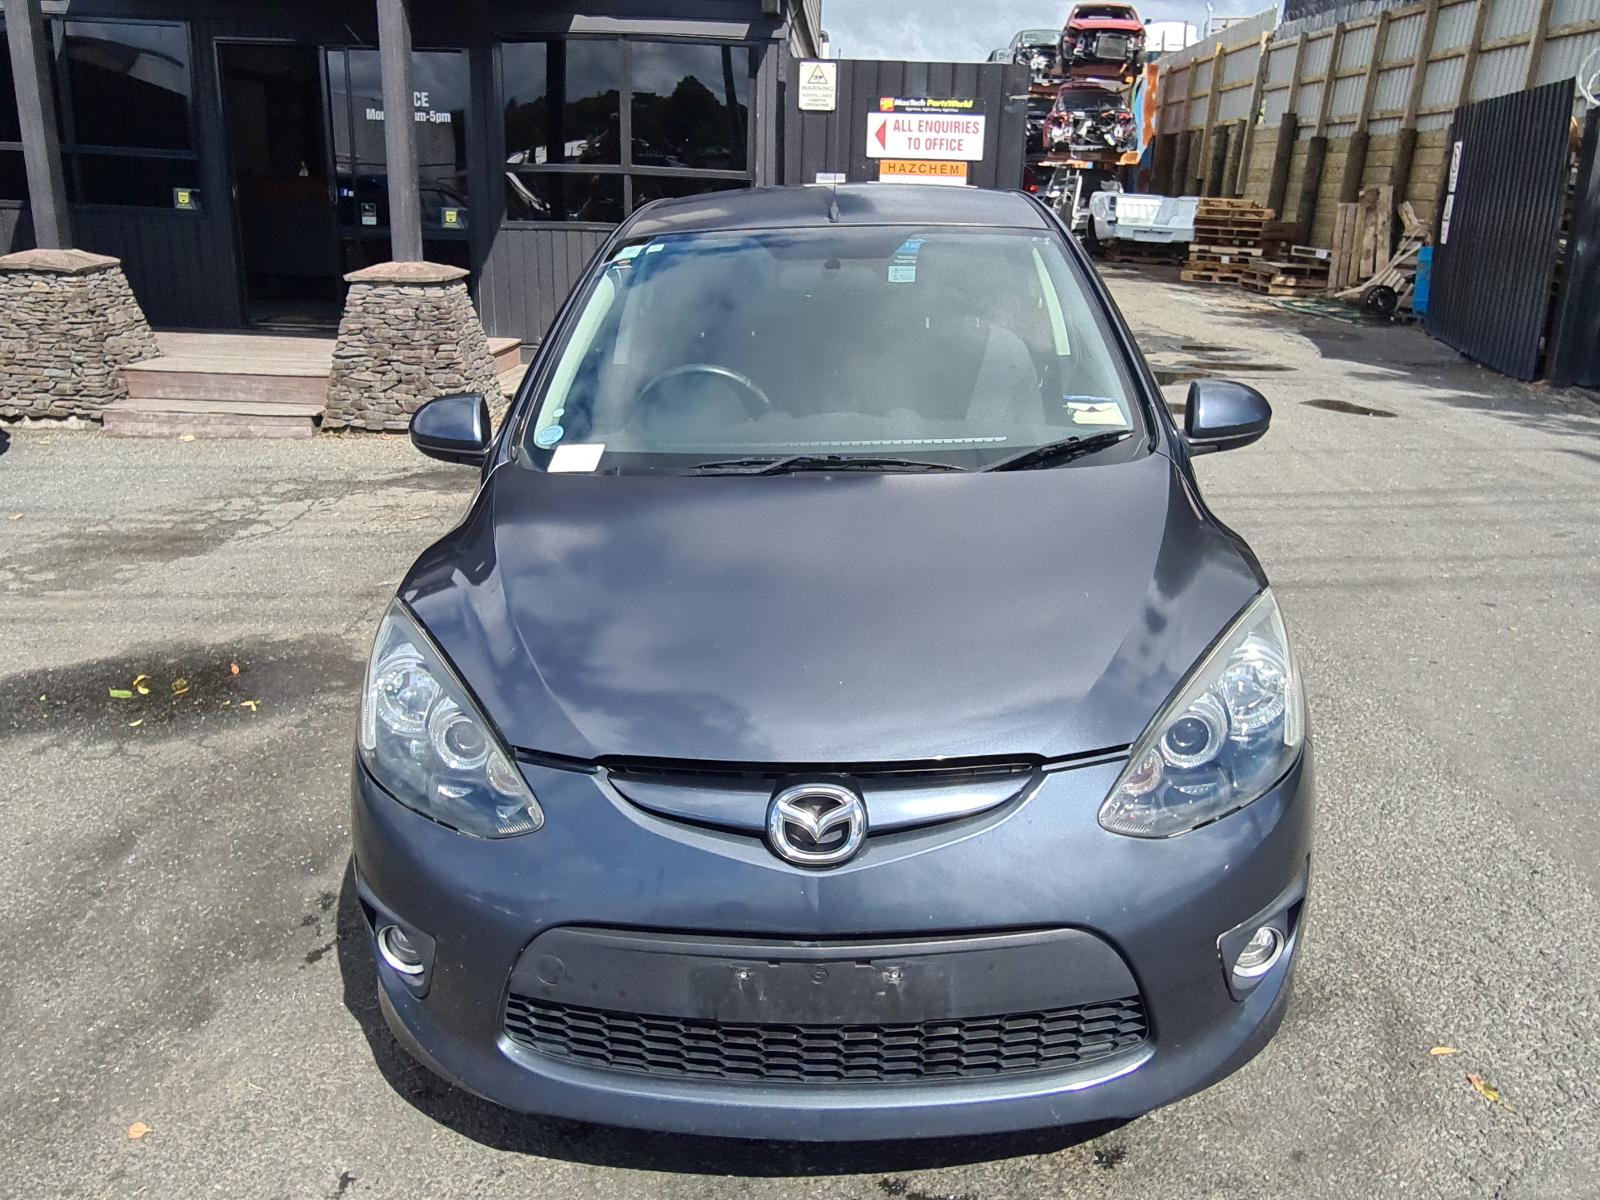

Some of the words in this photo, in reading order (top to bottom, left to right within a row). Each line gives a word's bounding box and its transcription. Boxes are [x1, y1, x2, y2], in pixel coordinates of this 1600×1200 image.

[893, 120, 913, 132] ALL
[918, 120, 979, 134] ENQUIRIES
[907, 137, 921, 150] TO
[925, 138, 964, 151] OFFICE
[887, 164, 960, 174] HAZCHEM
